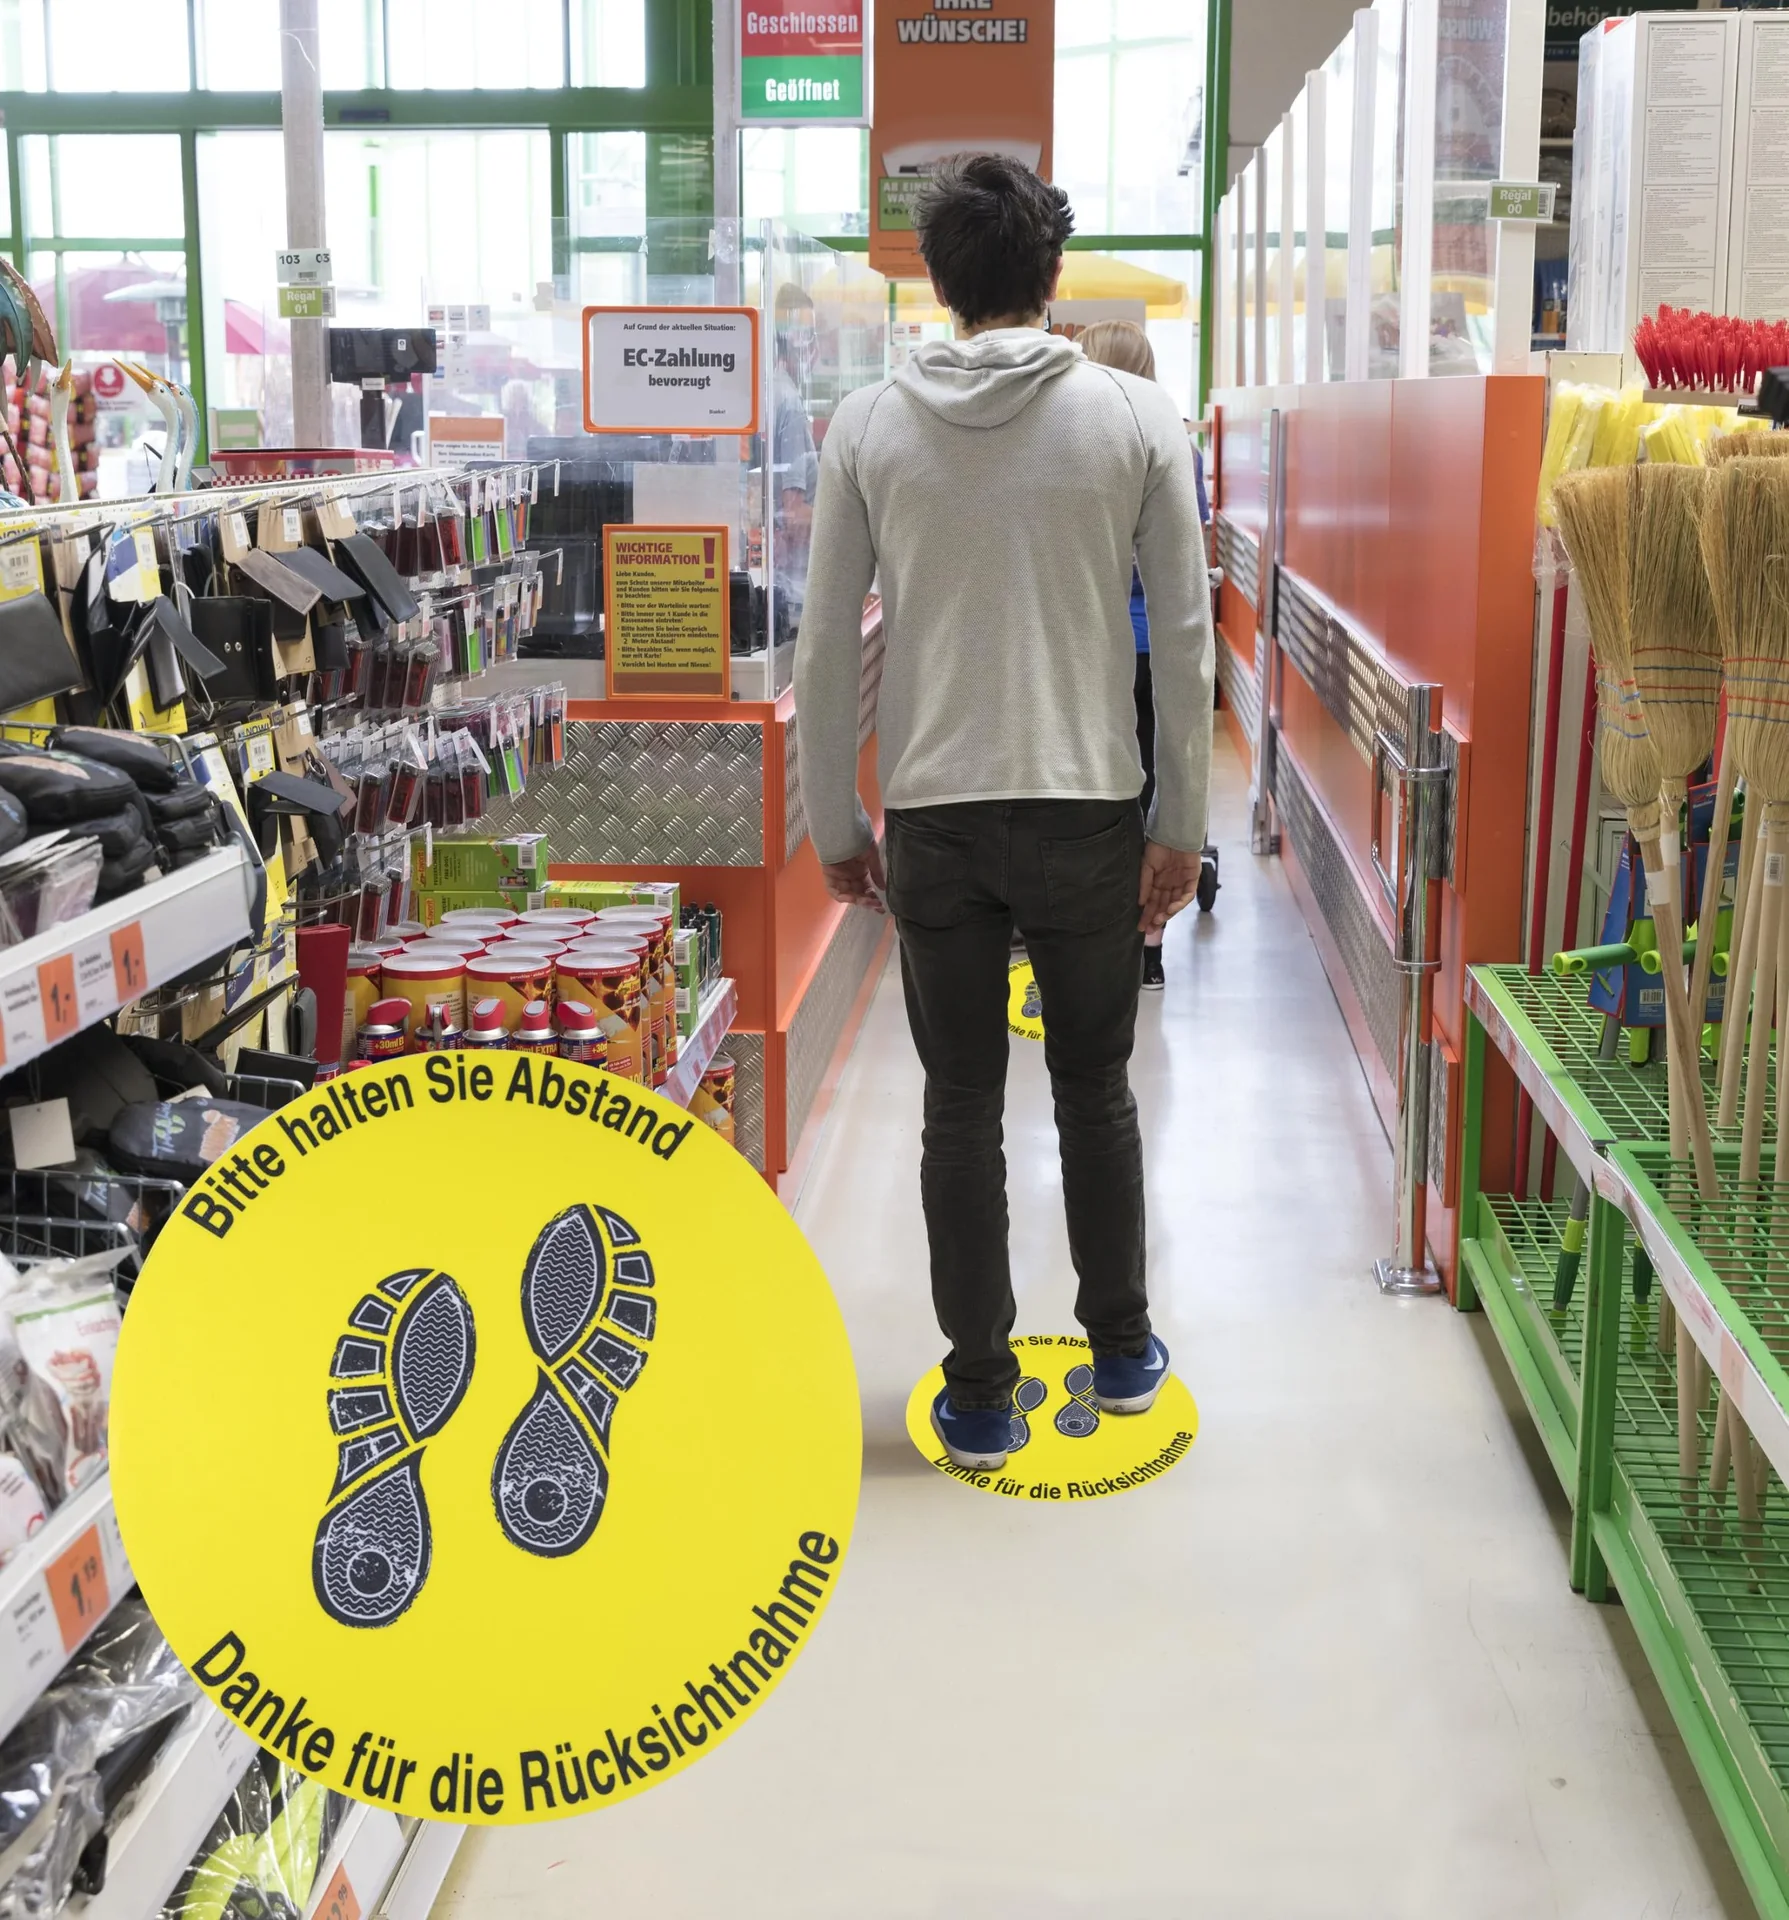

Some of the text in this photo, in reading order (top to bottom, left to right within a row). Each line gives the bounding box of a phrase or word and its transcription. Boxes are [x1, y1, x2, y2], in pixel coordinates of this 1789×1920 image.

[747, 12, 859, 35] Geschlossen
[897, 14, 1028, 43] WÜNSCHE!
[765, 78, 841, 102] Geöffnet
[1499, 189, 1532, 204] Regal
[1507, 203, 1523, 214] 00
[279, 253, 330, 265] 103 03
[287, 289, 316, 304] Regal
[294, 303, 308, 314] 01
[623, 323, 636, 331] Auf
[623, 347, 736, 373] EC-Zahlung
[648, 374, 711, 390] bevorzugt
[615, 542, 673, 553] WICHTIGE
[615, 554, 701, 565] INFORMATION
[1028, 1335, 1053, 1346] Sie
[993, 1477, 1025, 1500] für
[1030, 1482, 1062, 1500] die
[1067, 1430, 1194, 1499] Rücksichtnahme
